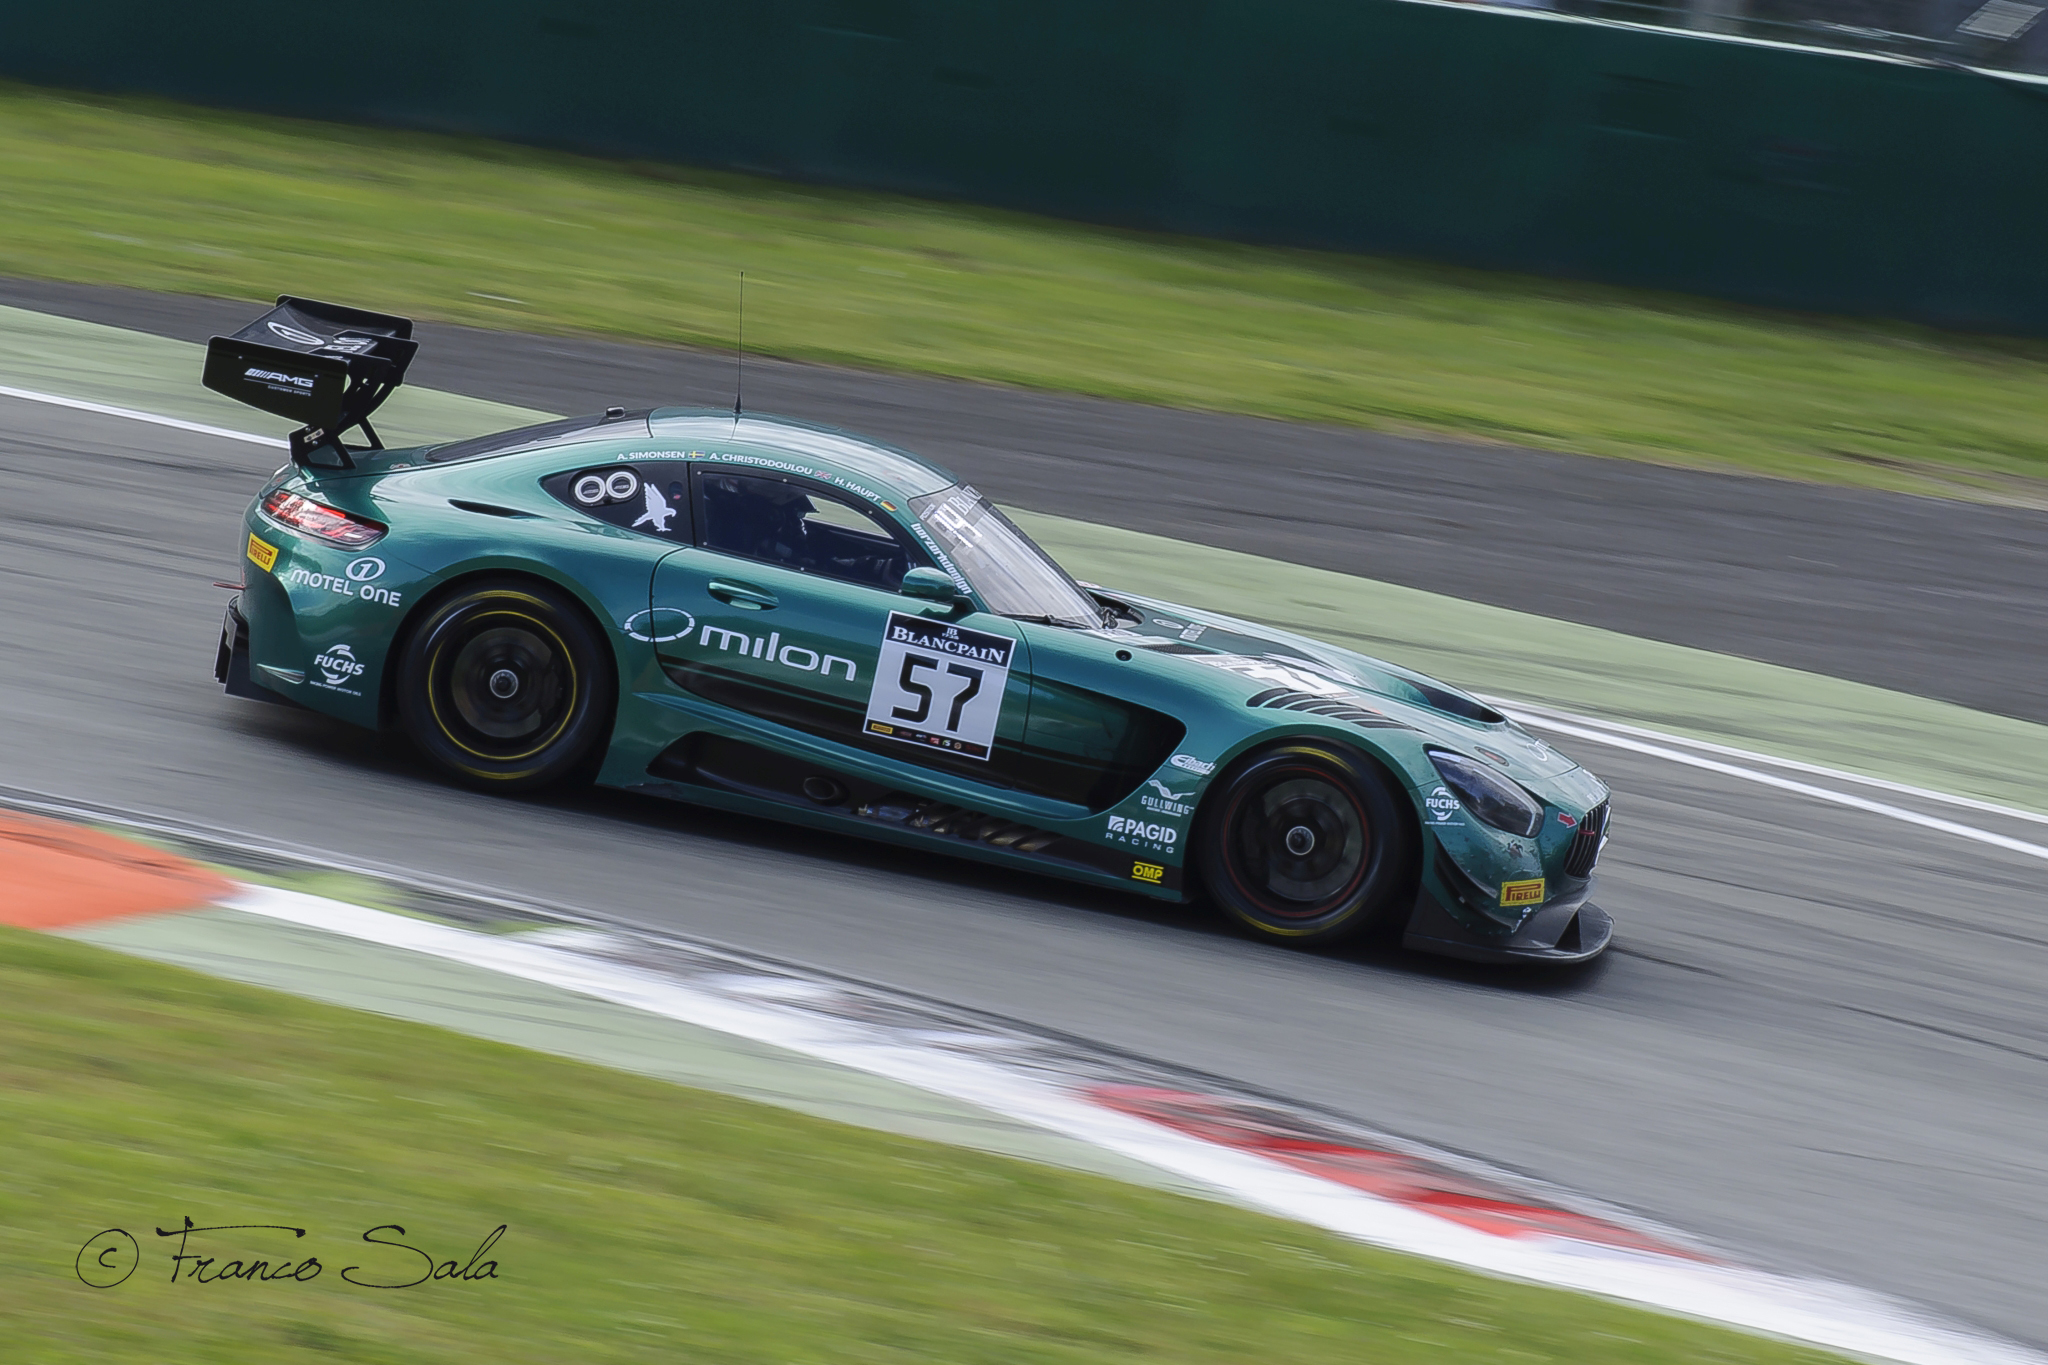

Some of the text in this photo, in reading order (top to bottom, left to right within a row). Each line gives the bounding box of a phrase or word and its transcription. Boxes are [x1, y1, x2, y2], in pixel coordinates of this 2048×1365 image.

[266, 372, 314, 388] AMG
[629, 450, 685, 460] SIMONSEN
[709, 453, 813, 475] A. CHRISTODOULOU
[833, 476, 881, 502] H. HAUPT
[290, 569, 402, 607] MOTEL ONE
[699, 624, 857, 682] milon
[891, 625, 1006, 664] BLANCPAIN
[313, 654, 365, 676] FUCHS
[890, 651, 984, 733] 57
[1141, 795, 1193, 815] GULLWING
[1425, 797, 1460, 810] FUCHS
[1124, 819, 1178, 844] PAGID
[1105, 832, 1174, 854] RACING
[1132, 865, 1163, 880] OMP
[1505, 883, 1541, 901] PIRELLI
